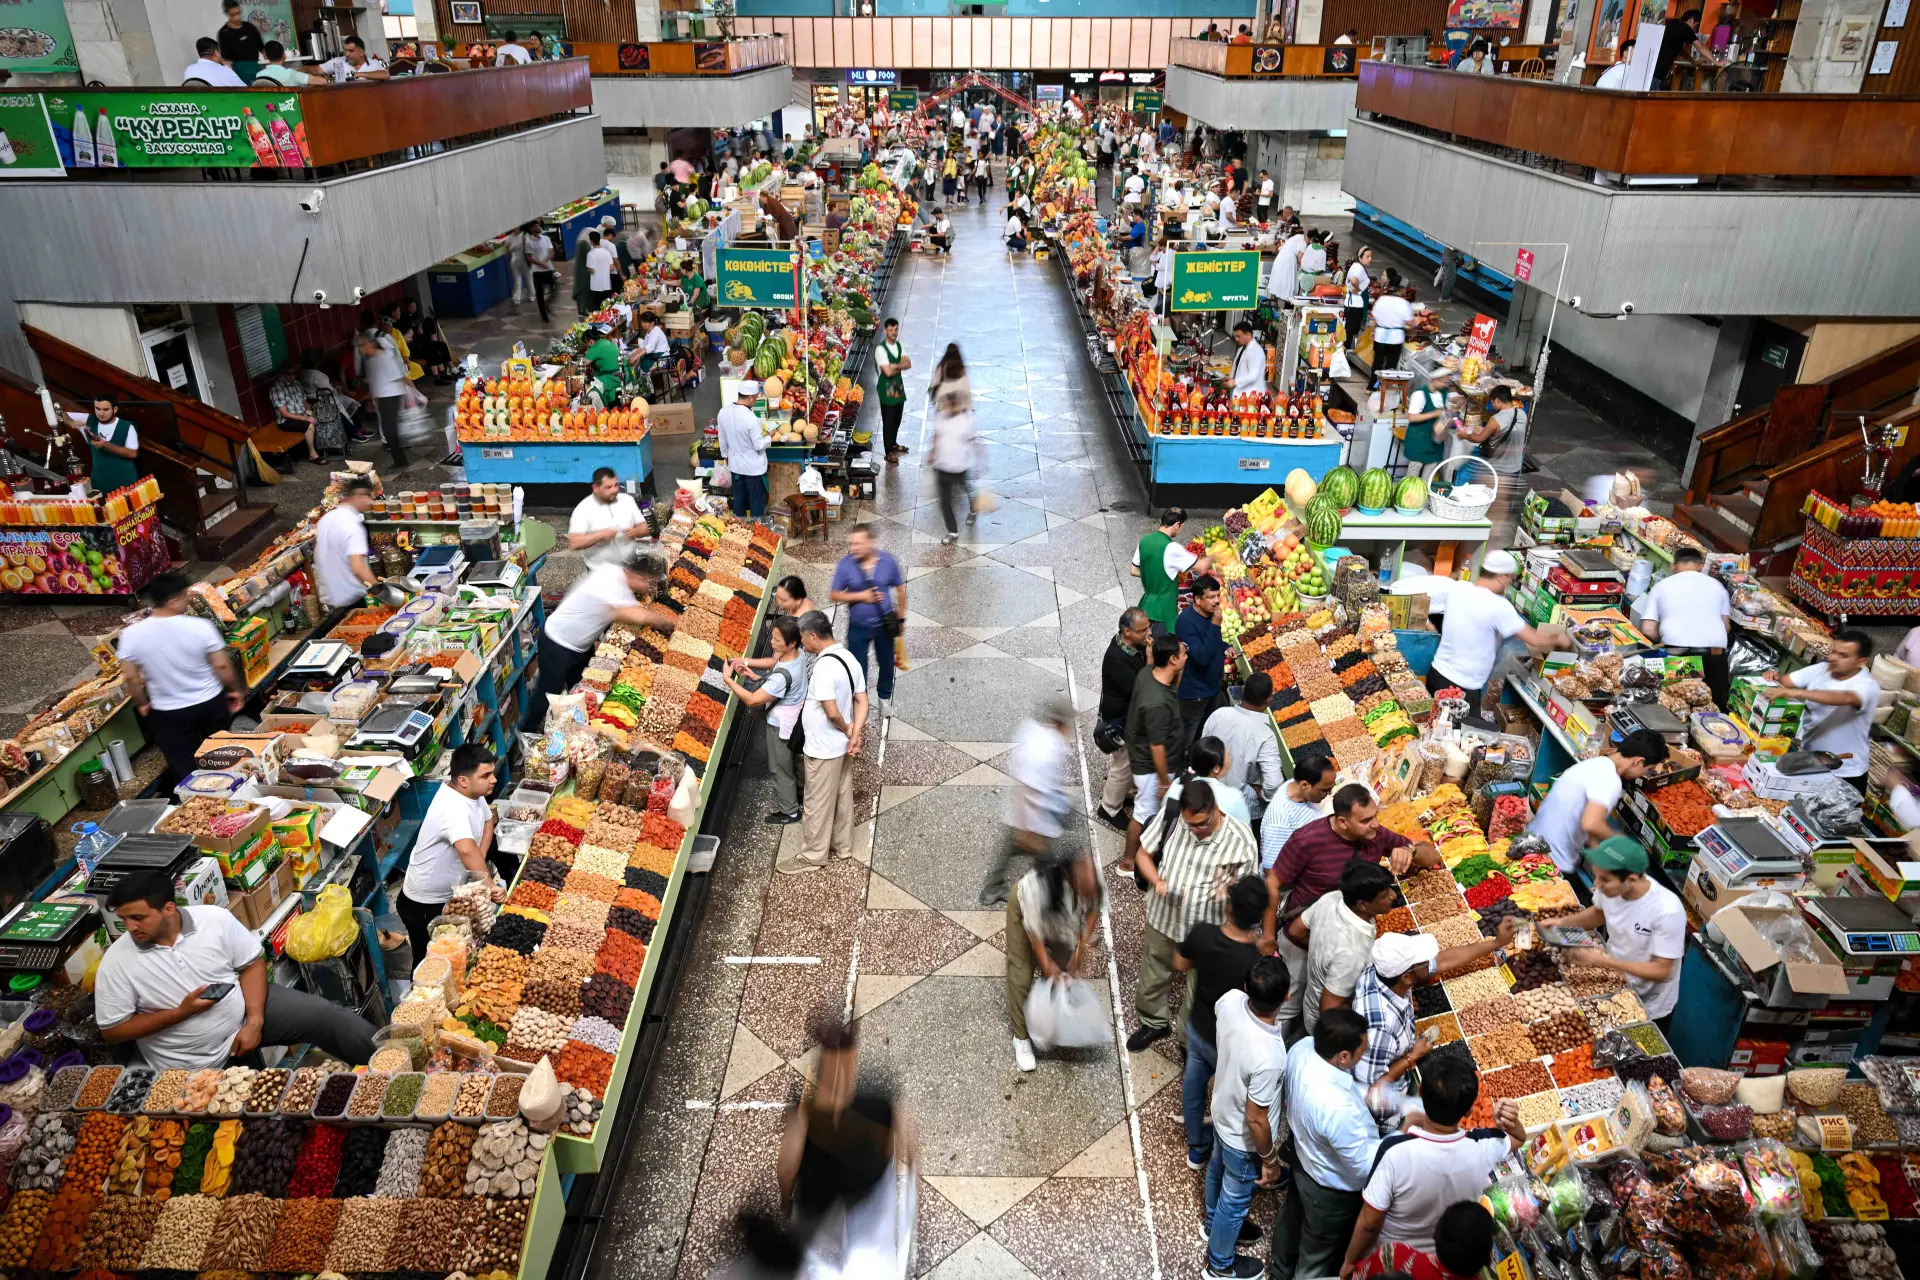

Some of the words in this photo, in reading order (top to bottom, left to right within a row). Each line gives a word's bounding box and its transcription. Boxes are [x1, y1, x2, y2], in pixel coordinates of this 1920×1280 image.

[851, 70, 865, 80] DELI
[878, 70, 896, 80] FOOD
[0, 95, 34, 107] ОБОЙ
[150, 103, 200, 115] АСХАНА
[146, 142, 225, 155] ЗАКУСОЧНАЯ
[1222, 294, 1249, 302] ФРУКТЫ
[115, 506, 156, 534] ГРАНАТОВЫЙ
[52, 531, 82, 543] СОК
[119, 529, 138, 546] СОК
[2, 545, 48, 556] ГРАНАТ
[207, 758, 230, 766] Орехи
[193, 870, 215, 901] Орехи
[1820, 1118, 1845, 1126] РИС
